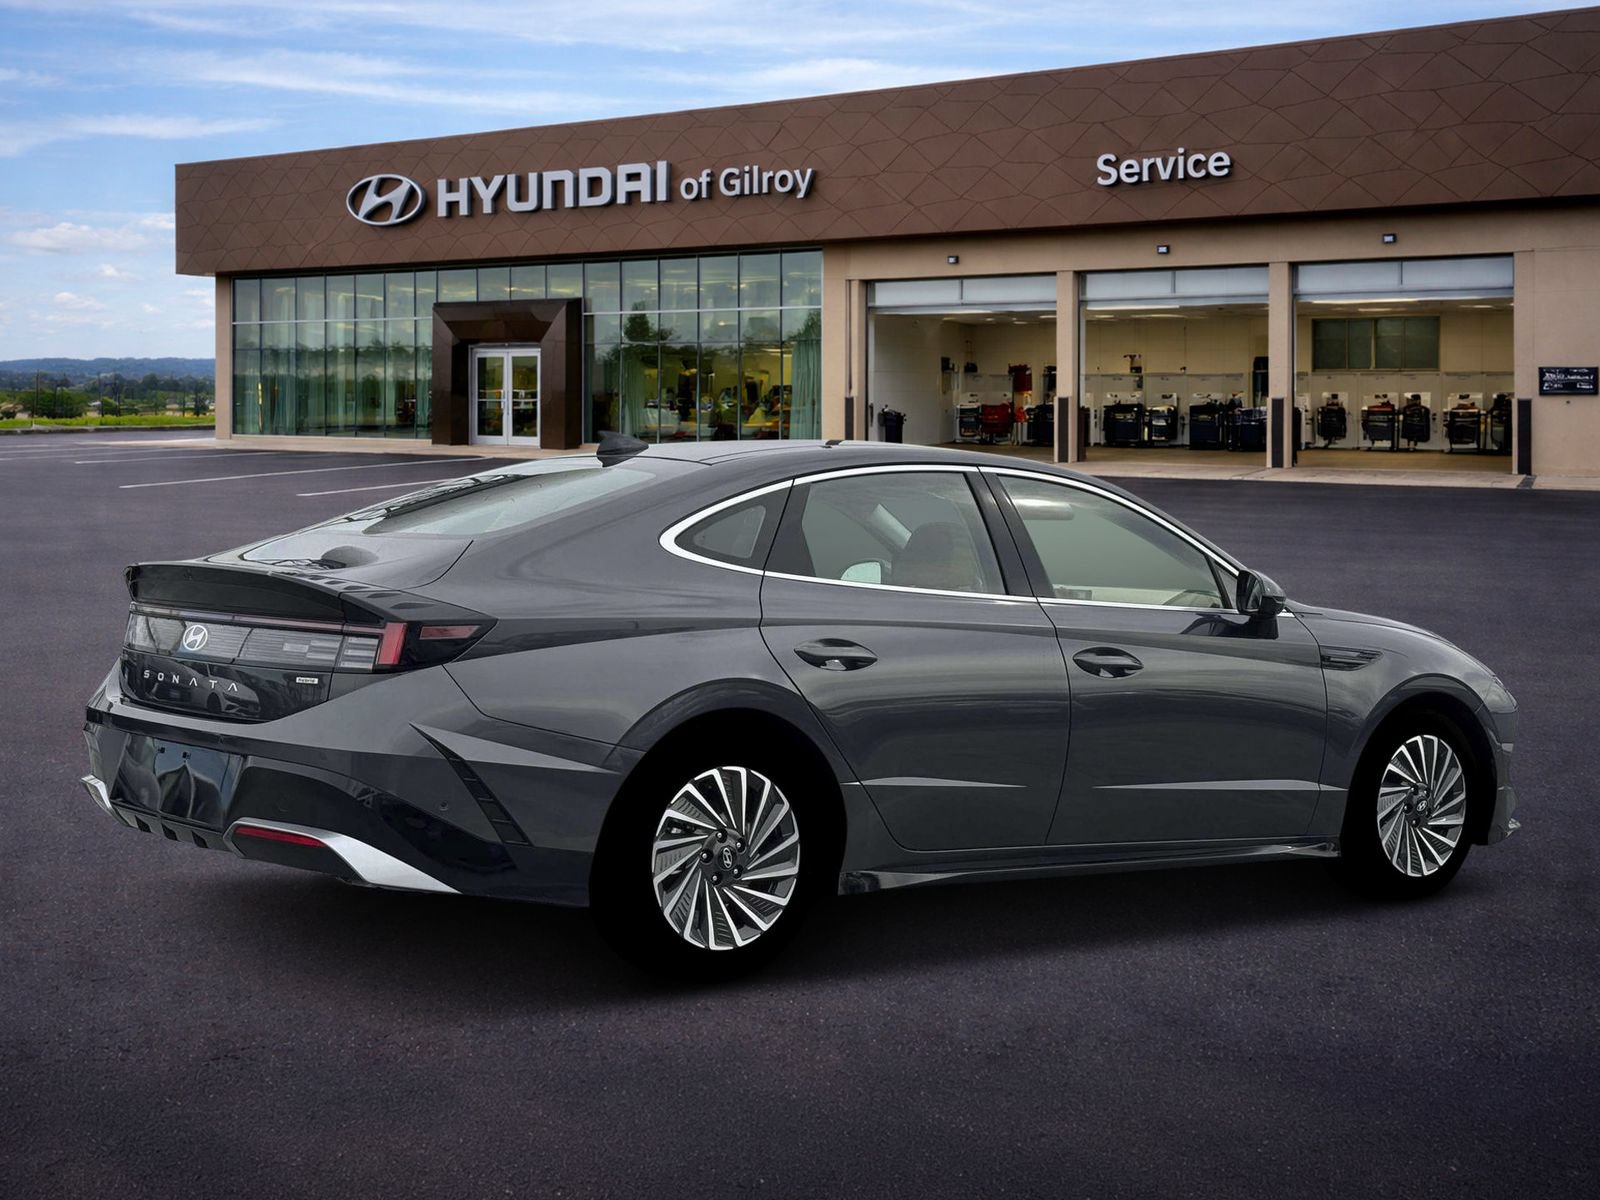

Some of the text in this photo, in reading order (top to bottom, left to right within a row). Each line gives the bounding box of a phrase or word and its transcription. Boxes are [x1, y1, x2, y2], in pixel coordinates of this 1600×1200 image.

[1096, 147, 1231, 186] Service
[437, 160, 812, 217] HYUNDAI of Gilroy
[143, 669, 238, 692] SONATA
